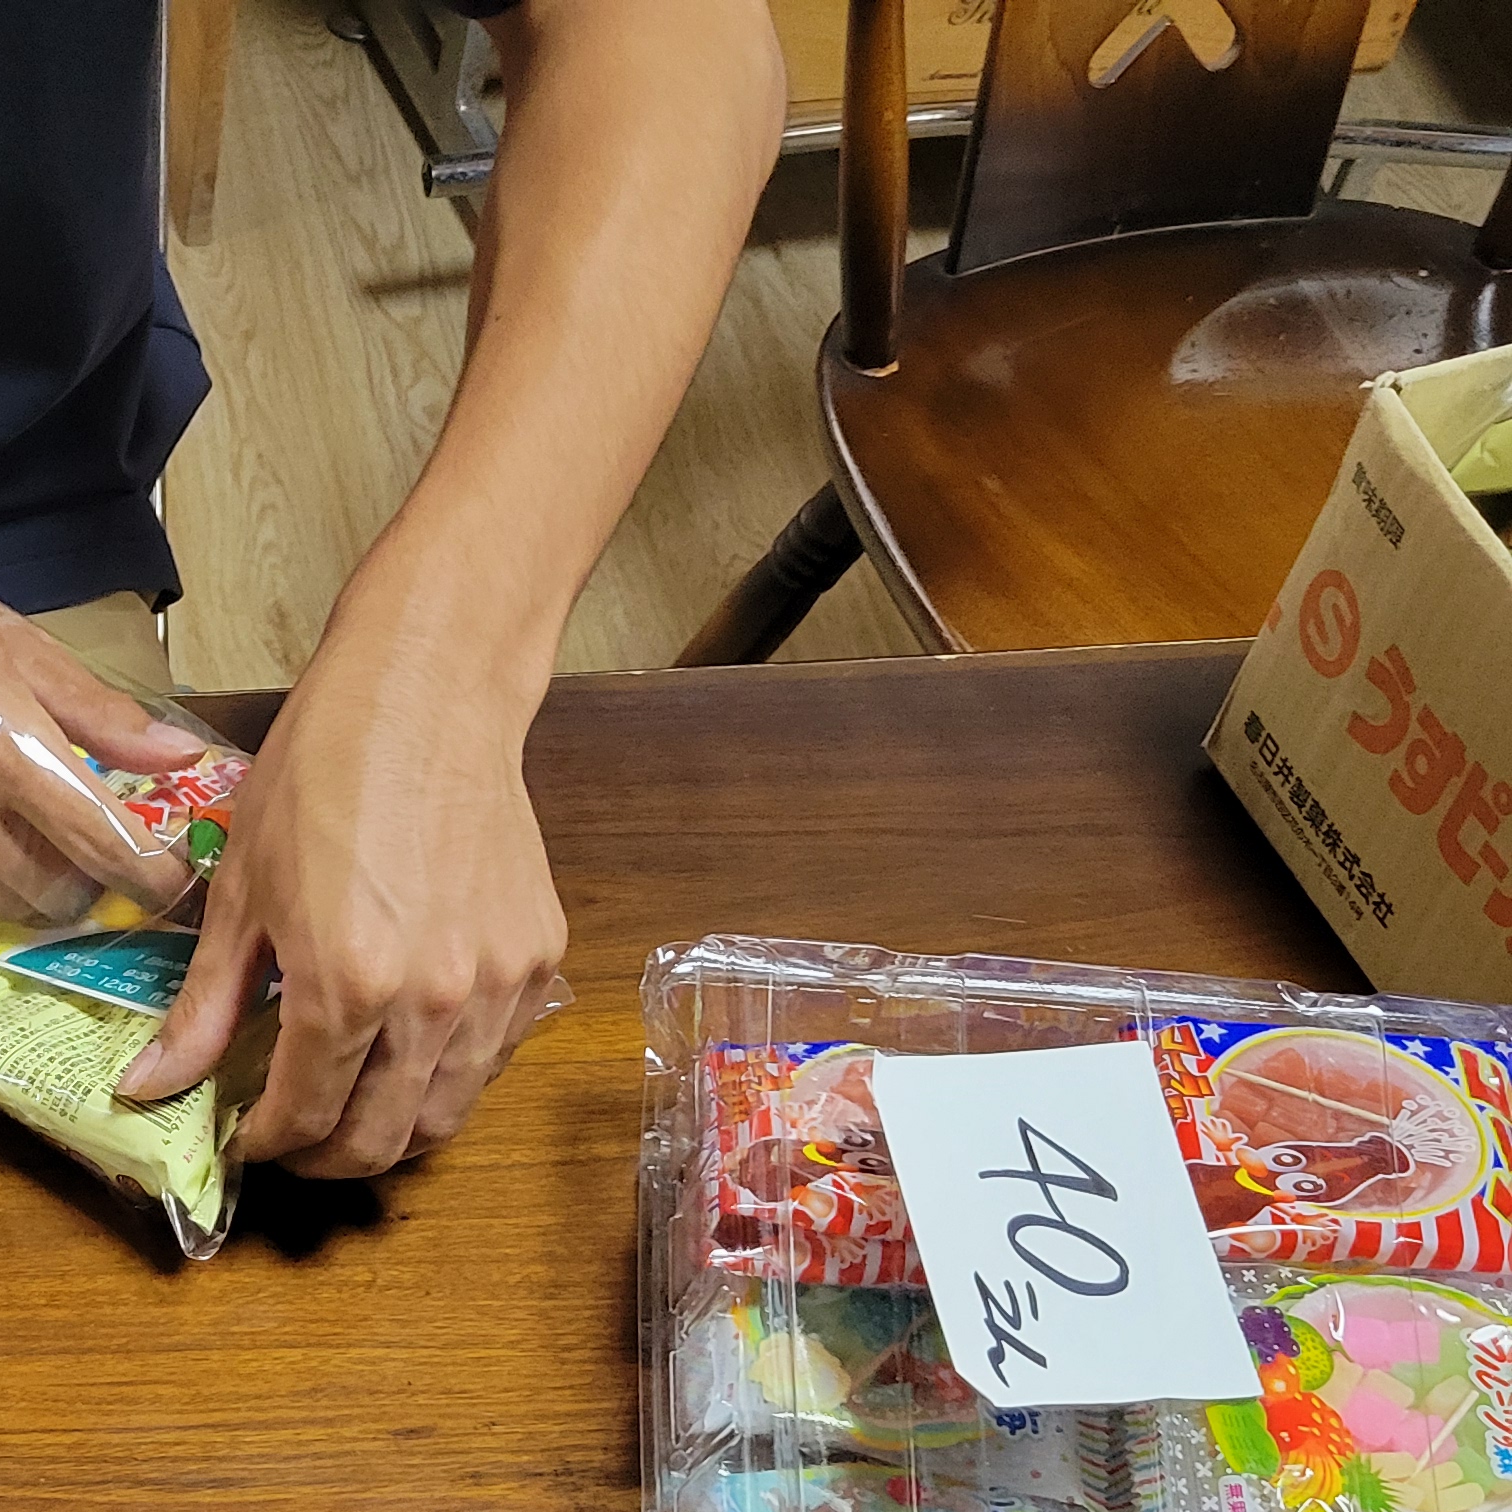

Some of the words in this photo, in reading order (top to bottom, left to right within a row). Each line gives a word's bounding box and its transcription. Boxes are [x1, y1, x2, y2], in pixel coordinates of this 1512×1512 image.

[1242, 710, 1396, 930] 春日井製菓株式会社
[1347, 643, 1512, 958] うすピー
